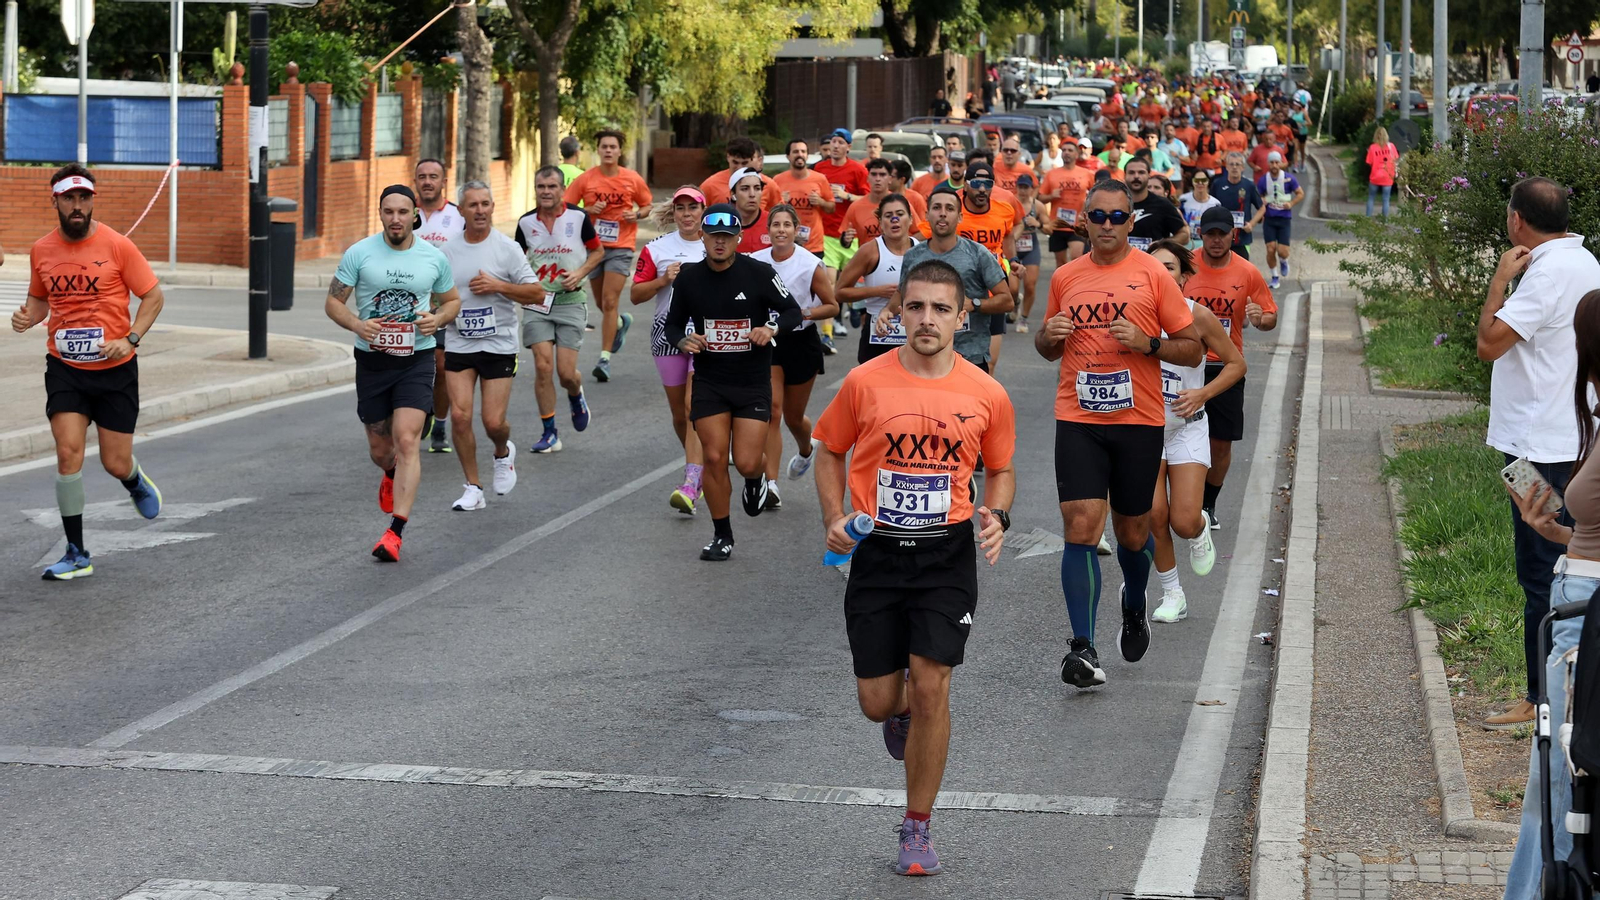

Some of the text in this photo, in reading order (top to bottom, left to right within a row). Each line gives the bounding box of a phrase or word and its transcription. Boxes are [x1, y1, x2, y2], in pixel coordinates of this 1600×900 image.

[50, 275, 99, 292] XXIX
[1069, 302, 1128, 323] XXIX
[464, 318, 485, 328] 999
[380, 334, 404, 345] 530
[716, 331, 740, 341] 529
[67, 340, 92, 352] 877
[1089, 386, 1119, 400] 984
[884, 432, 963, 463] XXIX
[886, 458, 908, 468] MEDIA
[910, 460, 949, 471] MARATÓN
[893, 491, 929, 512] 931
